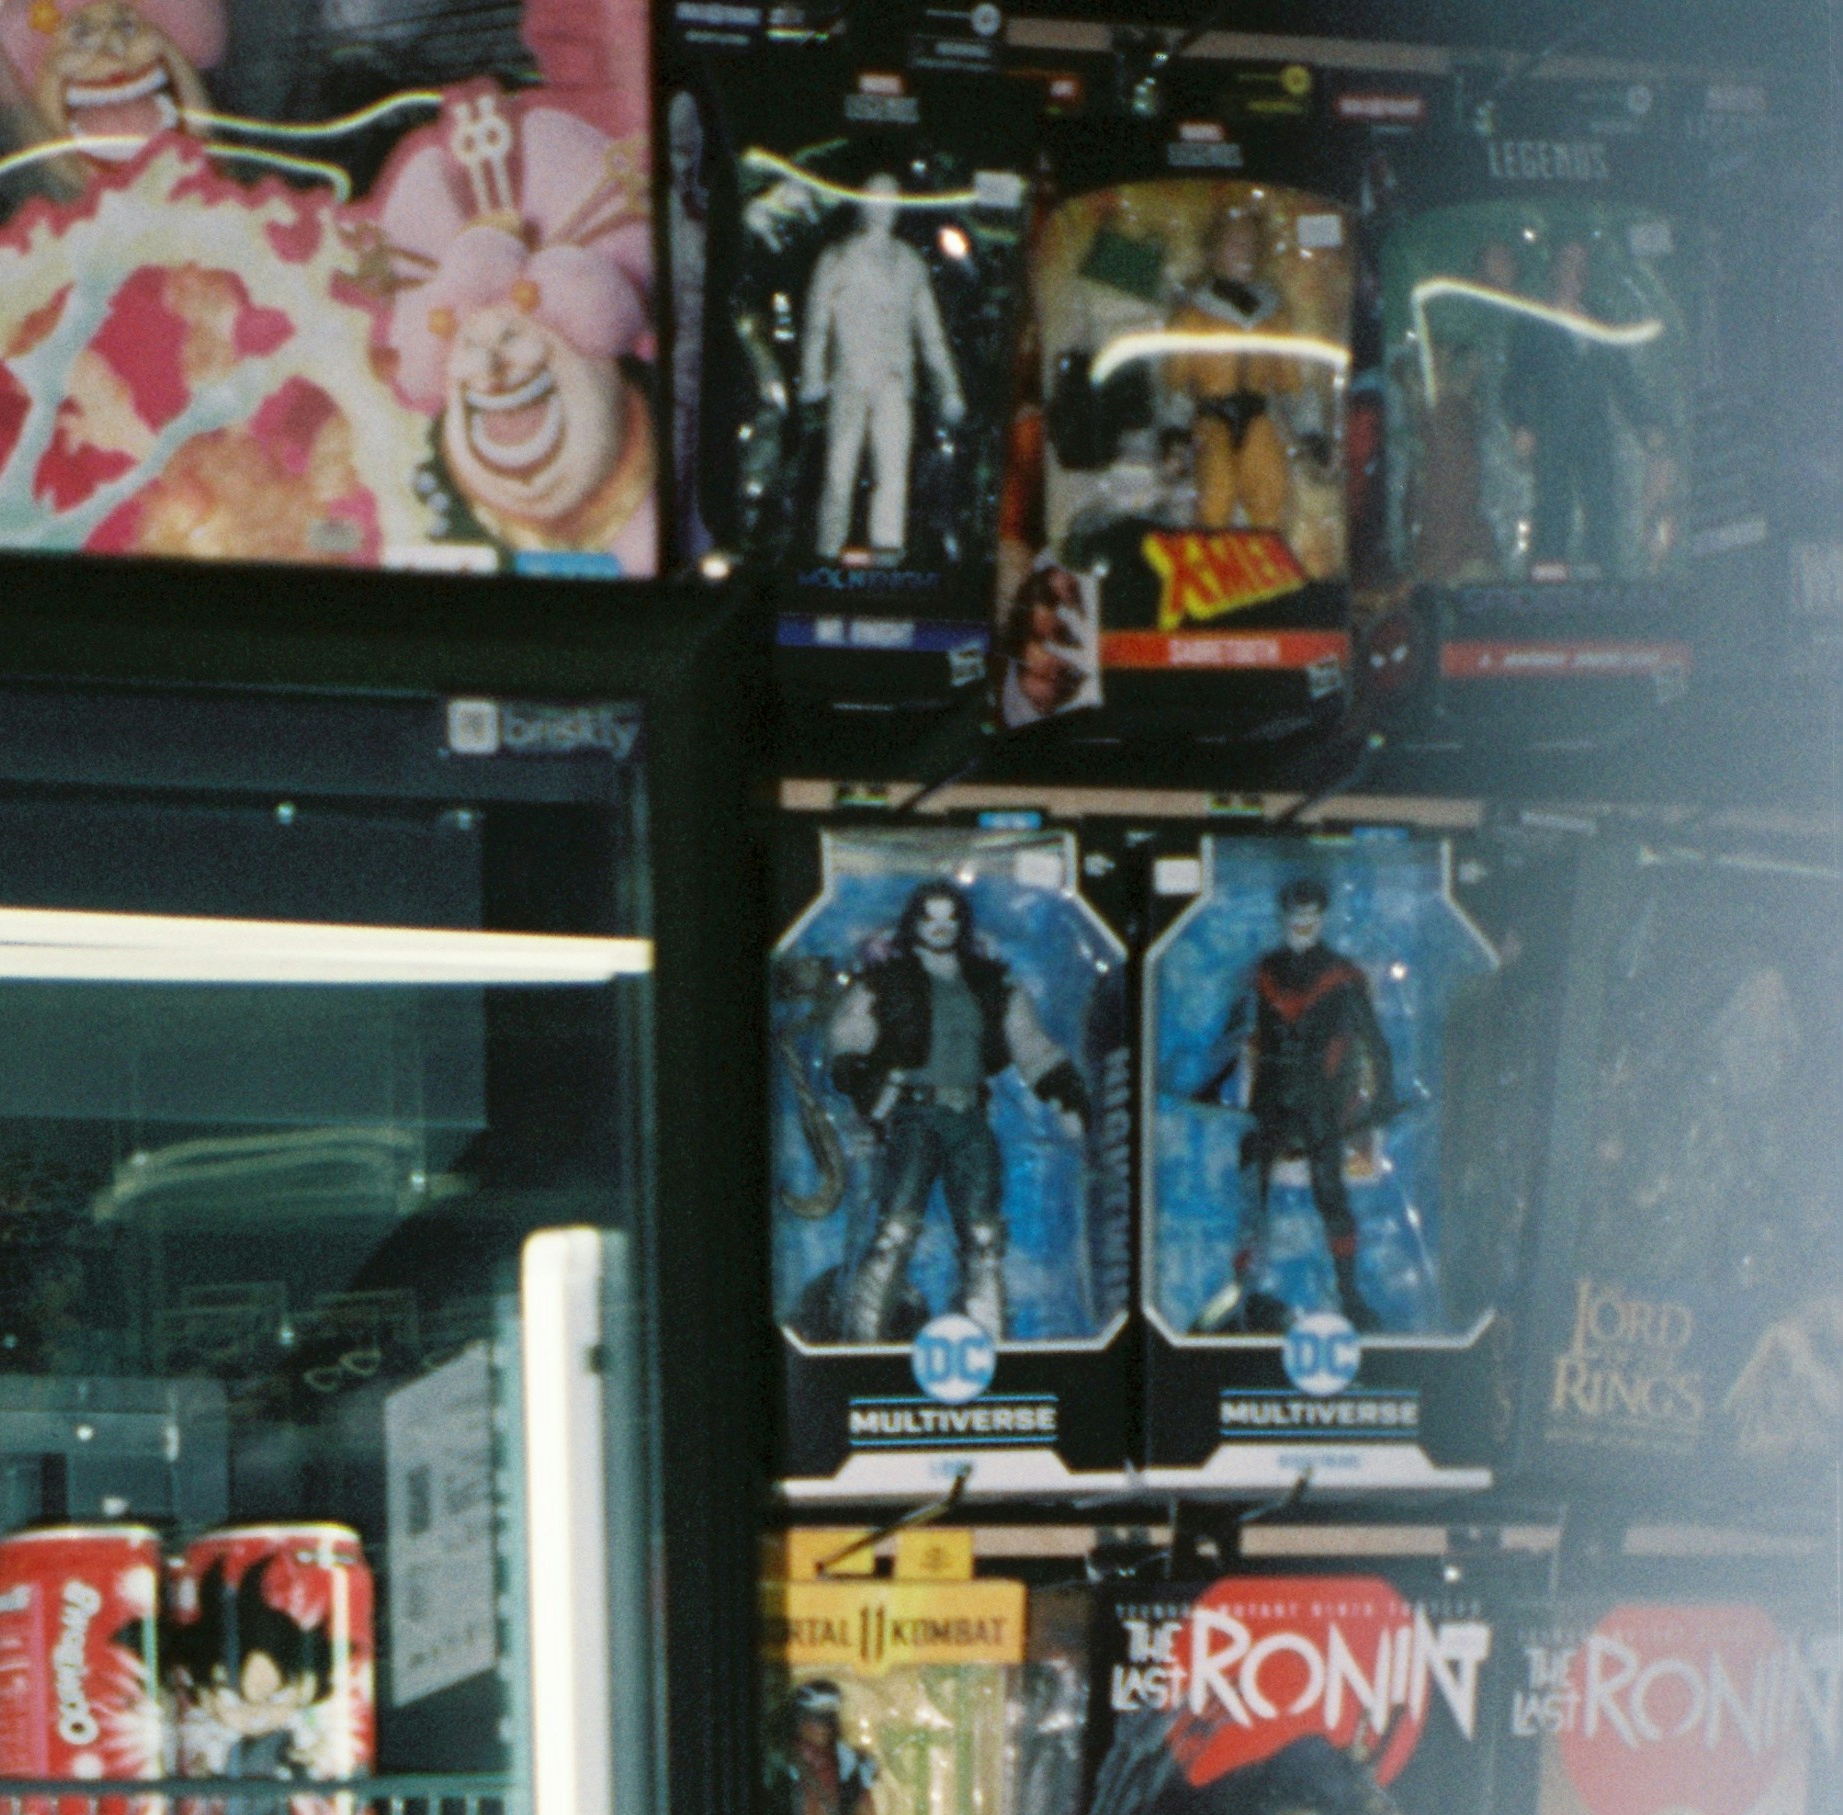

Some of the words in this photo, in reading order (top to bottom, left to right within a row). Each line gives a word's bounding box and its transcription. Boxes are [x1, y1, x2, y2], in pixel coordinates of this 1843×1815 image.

[915, 1339, 995, 1381] DC
[1286, 1331, 1359, 1376] DC
[1551, 1356, 1705, 1419] RINGS
[848, 1405, 1058, 1435] MULTIVERSE
[1220, 1399, 1420, 1426] MULTIVERSE
[889, 1616, 1006, 1648] KOMBAT
[1123, 1621, 1183, 1663] THE
[1110, 1664, 1188, 1711] LAST
[1188, 1608, 1491, 1742] RONIN
